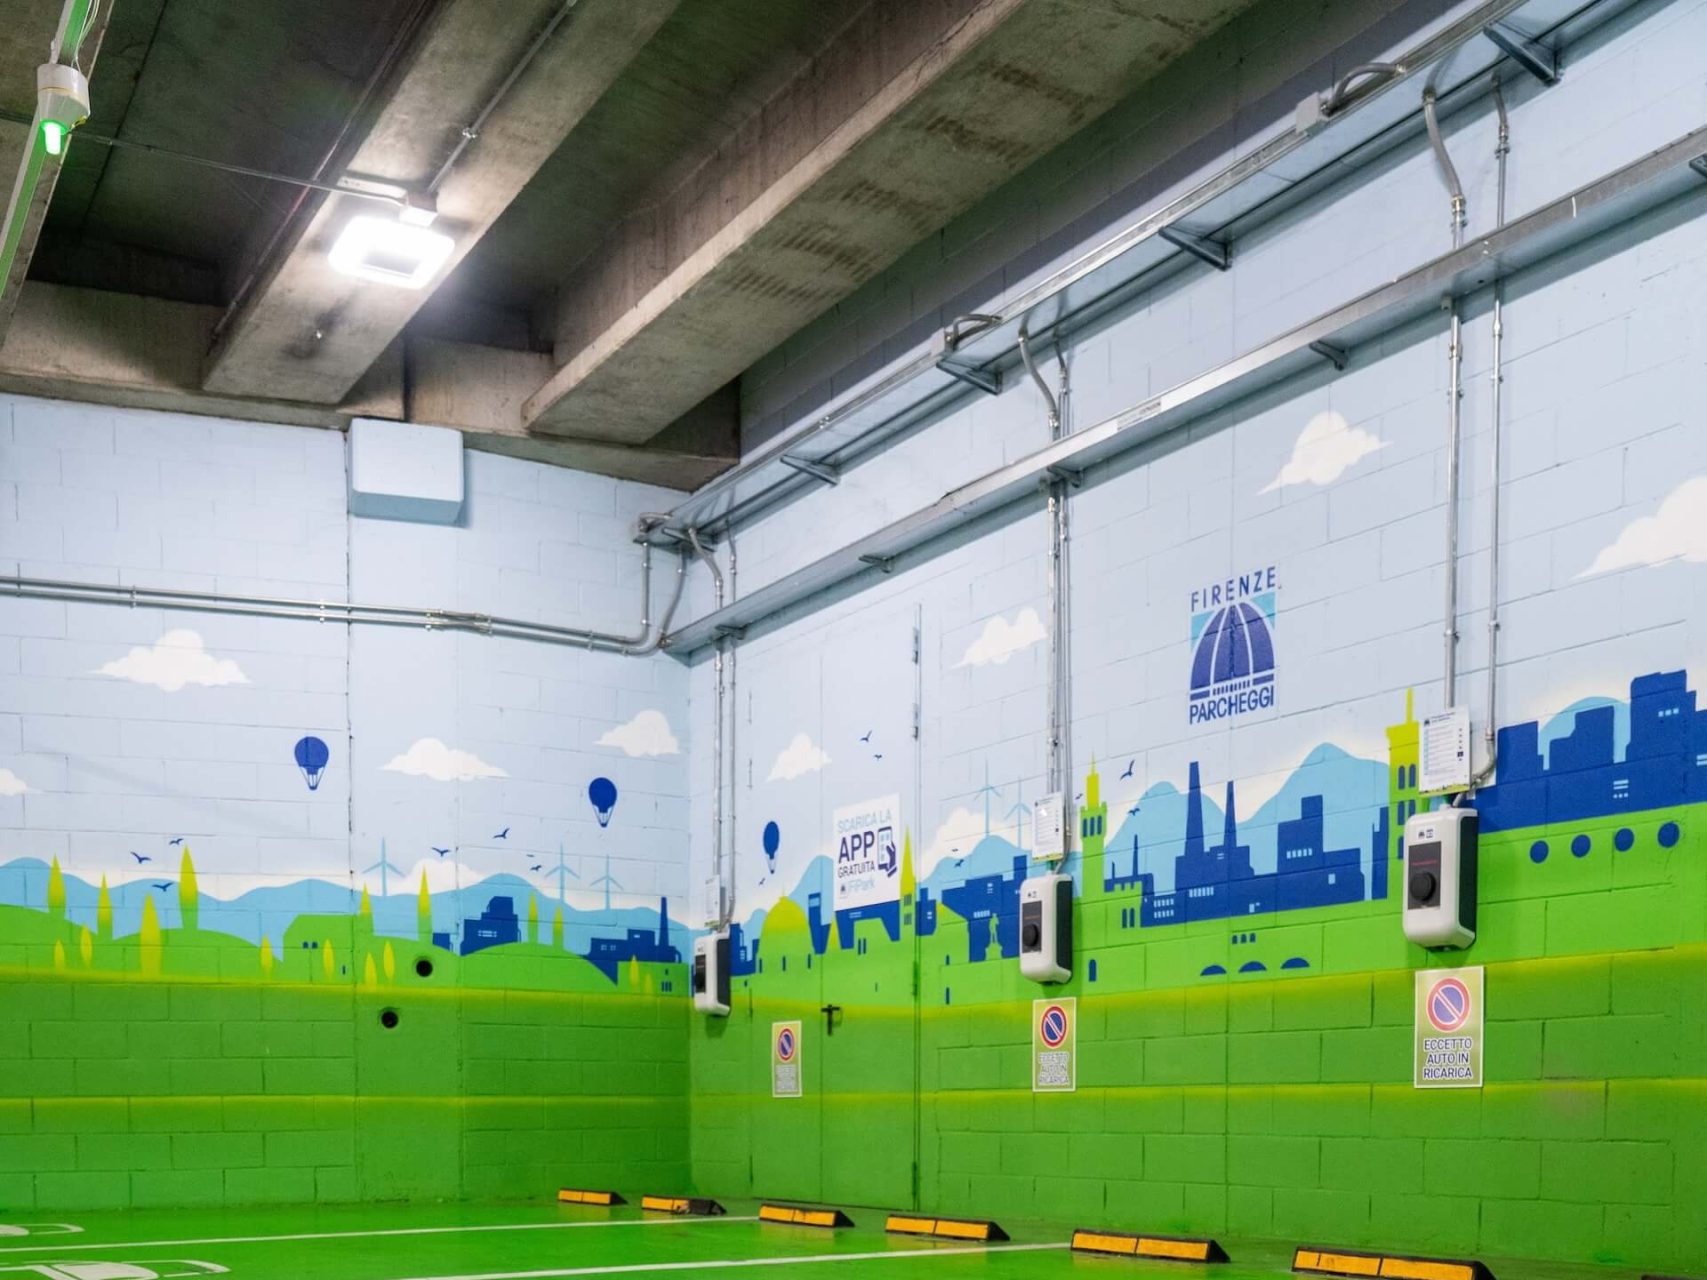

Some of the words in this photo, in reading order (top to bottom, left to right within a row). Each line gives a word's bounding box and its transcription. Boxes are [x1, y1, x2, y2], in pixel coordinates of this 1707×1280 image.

[1191, 566, 1276, 612] FIRENZE
[1189, 685, 1275, 725] PARCHEGGI
[838, 812, 877, 833] SCARICA
[879, 808, 892, 823] LA
[838, 831, 875, 864] APP
[837, 860, 876, 879] GRATUITA
[1424, 1038, 1472, 1050] ECCETTO
[1427, 1053, 1455, 1064] AUTO
[1458, 1052, 1469, 1063] IN
[1423, 1067, 1472, 1079] RICARICA
